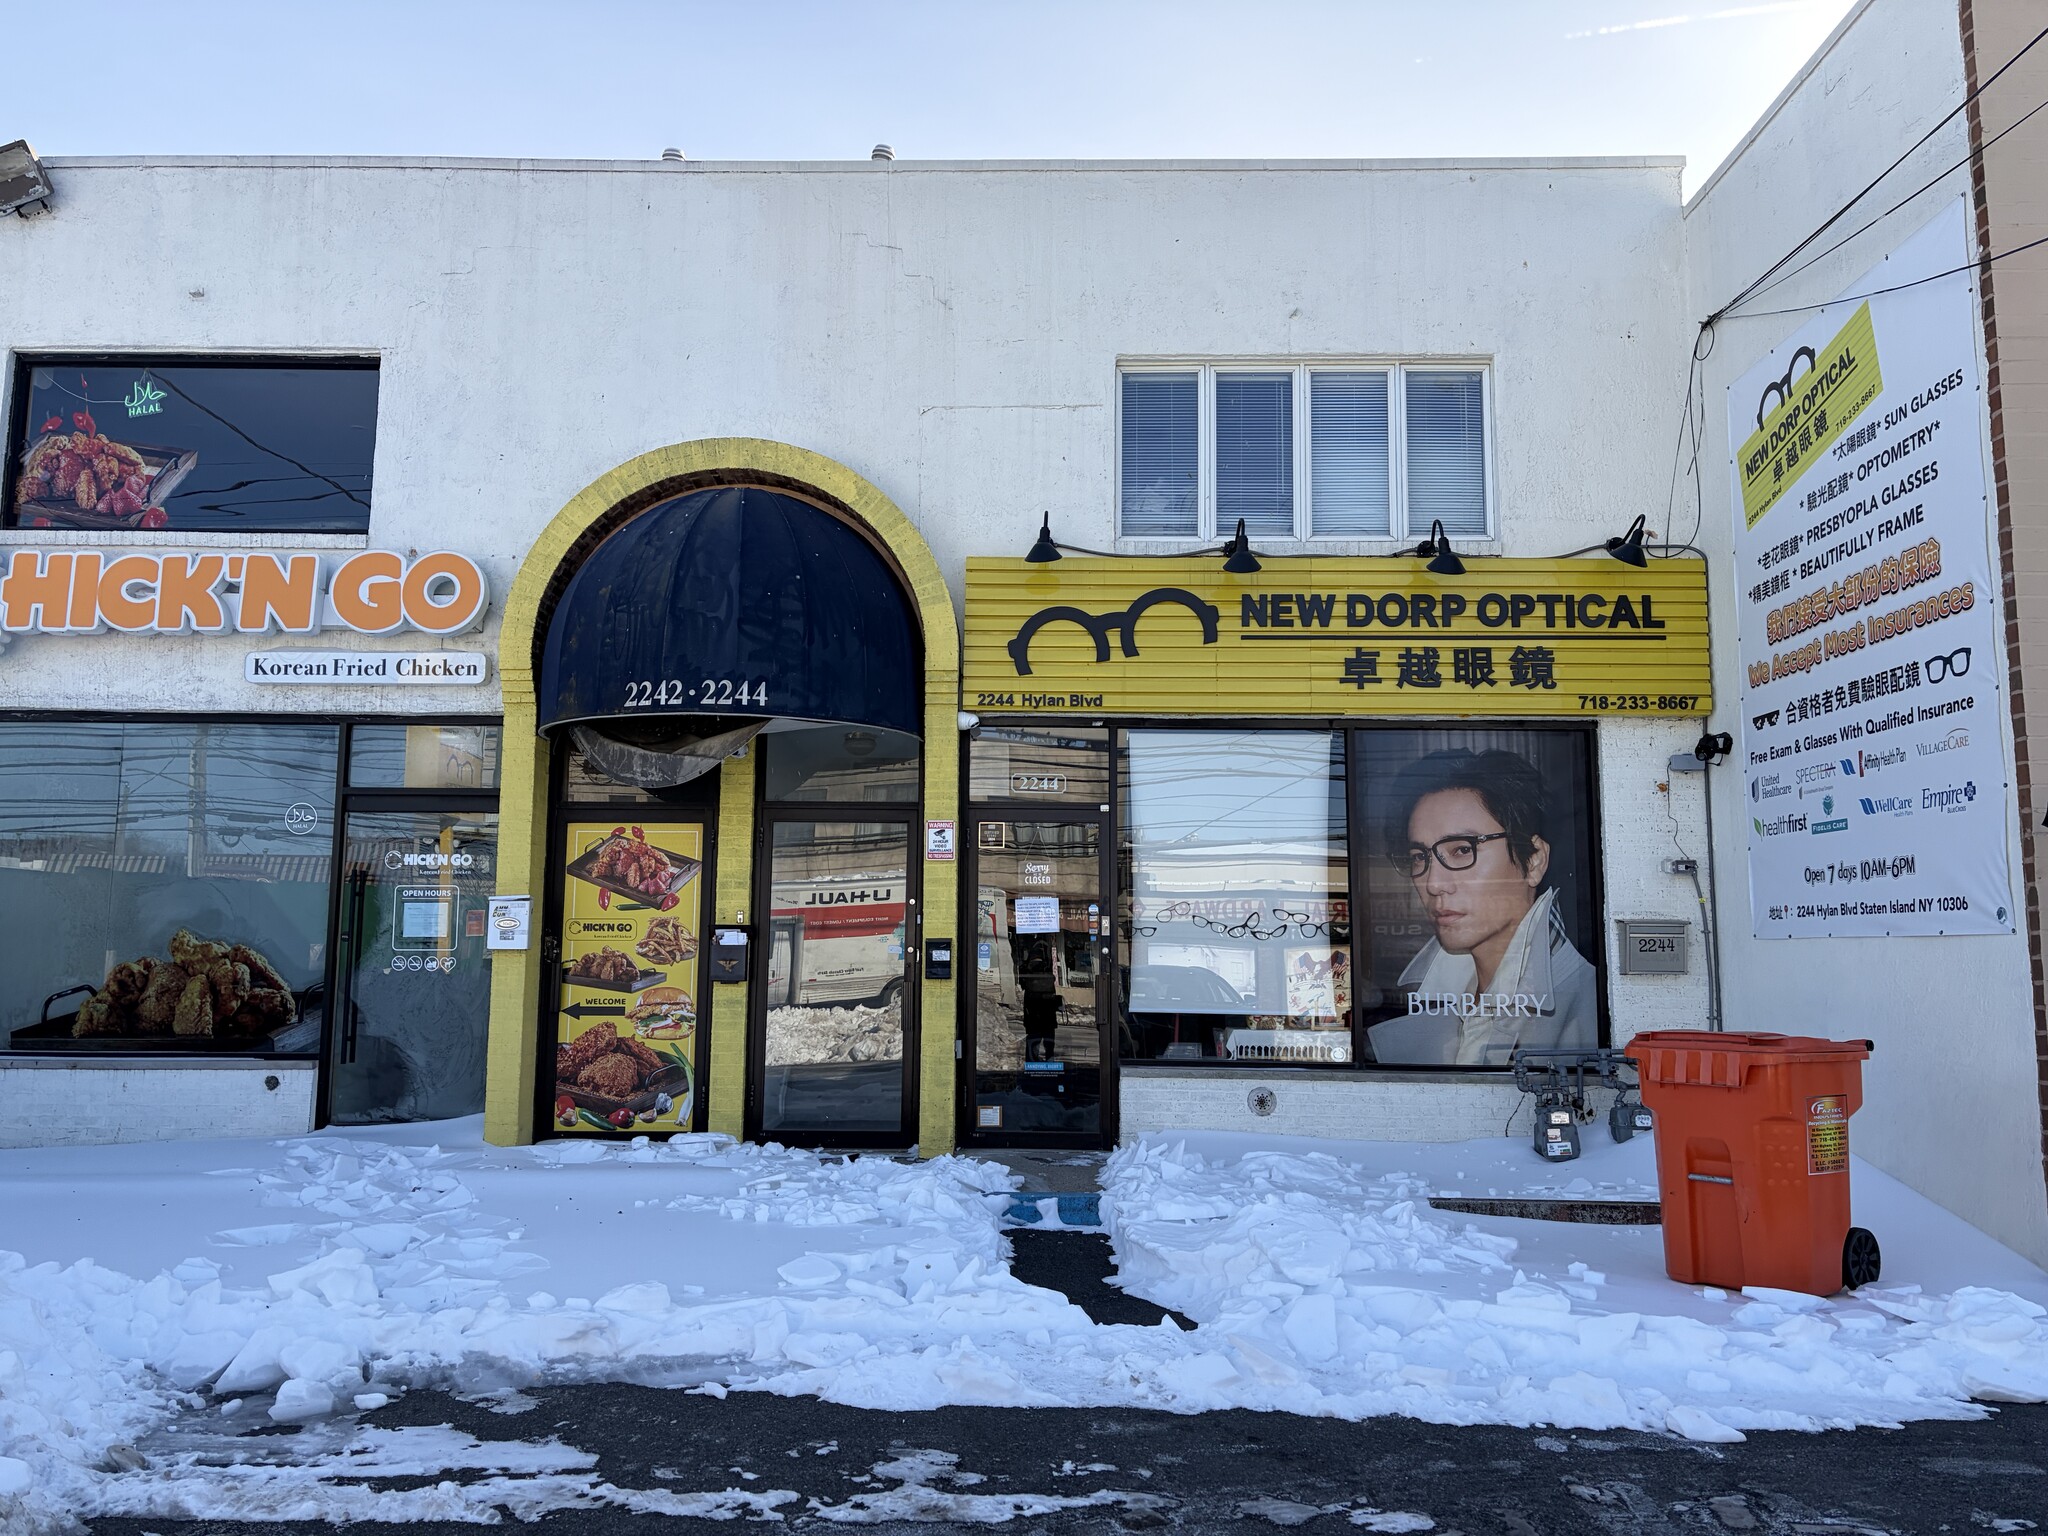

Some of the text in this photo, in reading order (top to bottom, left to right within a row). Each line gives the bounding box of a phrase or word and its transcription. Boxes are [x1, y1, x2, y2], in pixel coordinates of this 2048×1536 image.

[128, 403, 161, 417] HALAL
[1835, 384, 1877, 433] 718-233-8667
[1884, 402, 1908, 431] SUN
[1910, 368, 1963, 414] GLASSES
[1745, 346, 1856, 481] NEW DORP OPTICAL
[1772, 409, 1830, 485] 卓越眼鏡
[1806, 495, 1878, 546] PRESBYOPLA
[1881, 460, 1939, 506] GLASSES
[1800, 527, 1875, 580] BEAUTIFULLY
[1878, 505, 1925, 541] FRAME
[331, 551, 486, 633] GO
[1240, 593, 1666, 629] NEW DORP OPTICAL
[1748, 582, 1974, 689] We Accept Most Insurances
[252, 656, 479, 676] Korean Fried Chicken
[1340, 646, 1558, 690] 卓越眼鏡
[623, 678, 683, 707] 2242
[699, 679, 769, 706] 2244
[976, 693, 1104, 711] 2244 Hylan Blvd
[1578, 695, 1700, 711] 718-233-8667
[1750, 696, 1974, 766] Free Exam & Glasses With Qualified Insurance
[1019, 776, 1059, 790] 2244
[1761, 773, 1780, 787] United
[1762, 785, 1792, 799] Healthcare
[1921, 784, 1962, 812] Empire
[1875, 797, 1913, 813] WellCare
[1762, 813, 1807, 837] healthfirst
[450, 853, 473, 866] GO
[1025, 862, 1049, 874] Sorry
[1024, 876, 1051, 884] CLOSED
[1804, 867, 1825, 886] Open
[1828, 864, 1836, 885] 7
[1837, 863, 1857, 884] days
[1796, 904, 1815, 917] 2244
[1817, 903, 1839, 918] Hylan
[1840, 902, 1858, 916] Blvd
[1860, 901, 1887, 915] Staten
[1889, 898, 1916, 914] Island
[1918, 898, 1934, 912] NY
[1936, 896, 1968, 911] 10306
[616, 923, 632, 932] GO
[1638, 938, 1675, 952] 2244
[1407, 991, 1548, 1017] BURBERRY
